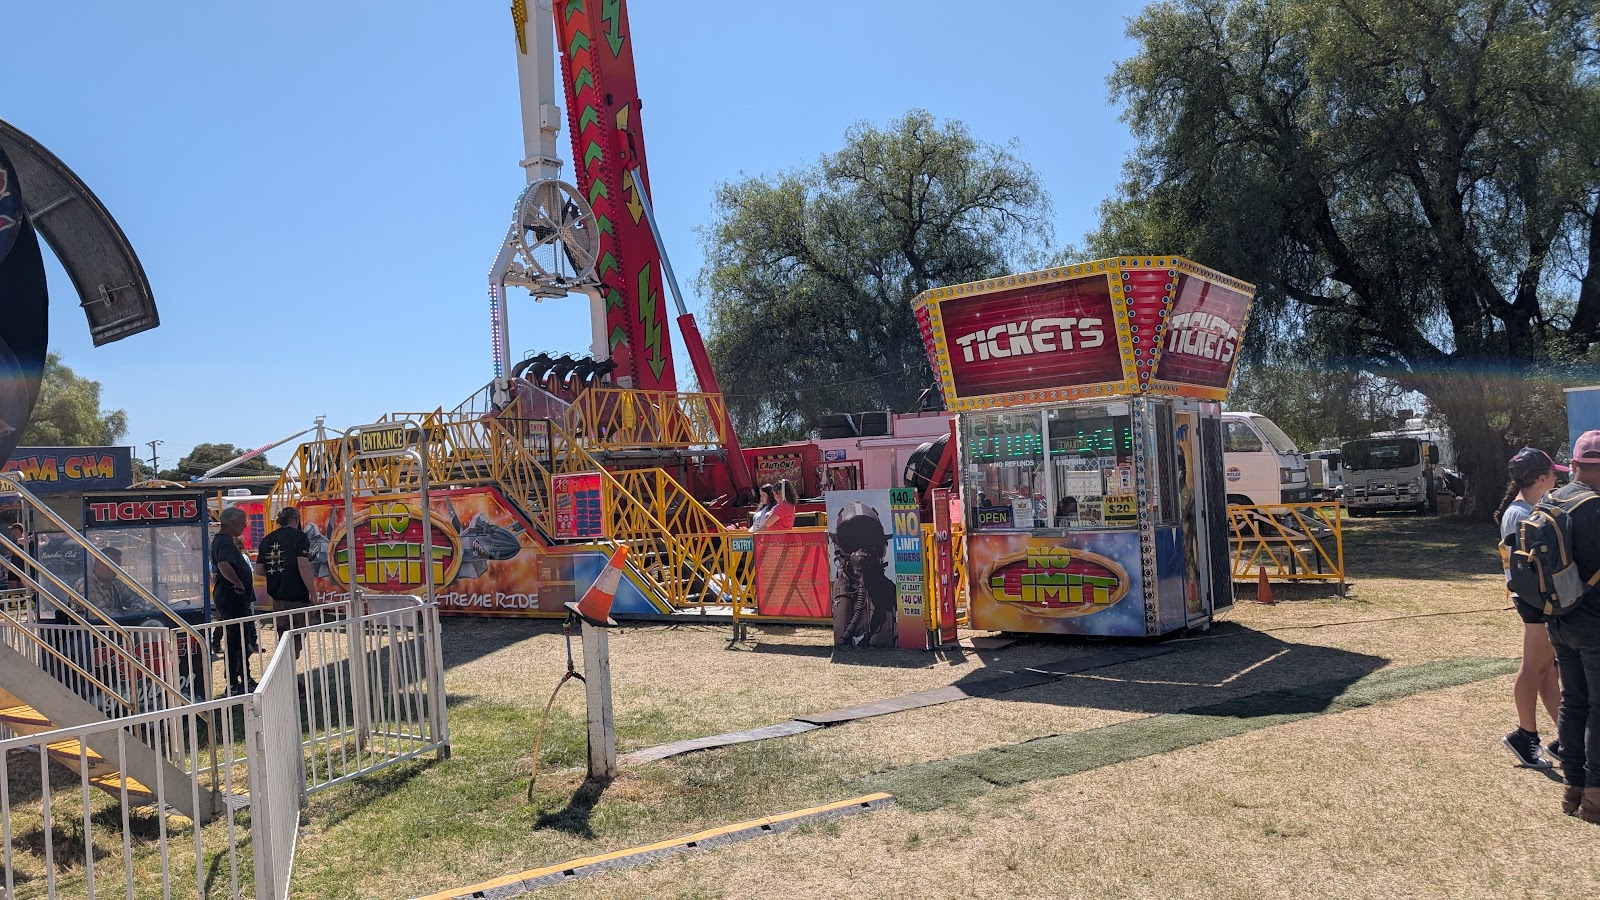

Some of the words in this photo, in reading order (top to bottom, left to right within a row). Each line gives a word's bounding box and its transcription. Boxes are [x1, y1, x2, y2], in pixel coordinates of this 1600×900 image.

[956, 317, 1105, 363] TICKETS
[1168, 311, 1239, 363] TICKETS
[362, 430, 402, 451] ENTRANCE
[759, 461, 794, 470] CAUTION!
[90, 500, 197, 521] TICKETS
[979, 513, 1007, 523] OPEN
[1109, 504, 1130, 513] $20
[370, 502, 410, 535] NO
[894, 512, 919, 536] NO
[896, 538, 920, 551] LIMIT
[937, 530, 948, 541] NO
[732, 541, 751, 550] ENTRY
[337, 543, 453, 584] LIMIT
[897, 552, 921, 562] RIDERS
[1026, 547, 1070, 568] NO
[991, 573, 1118, 604] LIMIT
[497, 592, 539, 609] RIDE
[901, 595, 912, 604] 140
[913, 595, 923, 604] CM
